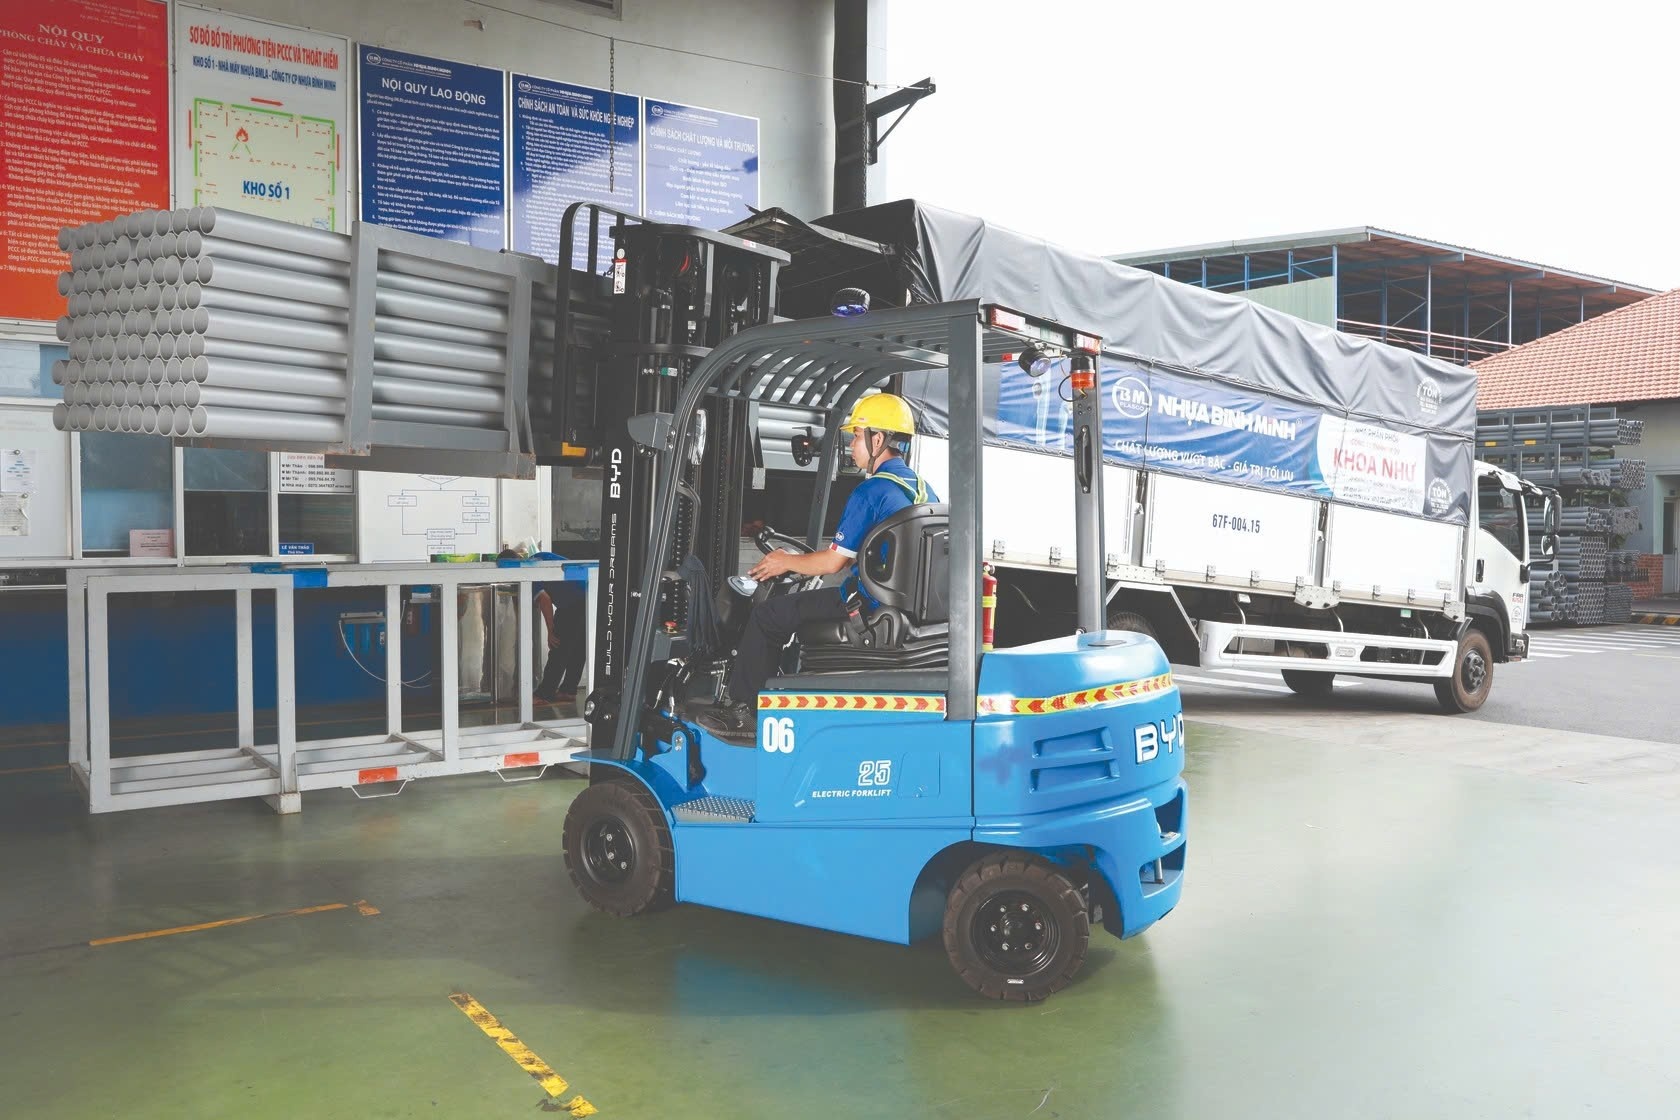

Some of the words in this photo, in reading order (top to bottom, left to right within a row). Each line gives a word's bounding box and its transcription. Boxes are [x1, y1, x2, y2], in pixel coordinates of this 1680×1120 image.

[37, 36, 68, 48] CHÁY
[117, 50, 145, 63] CHÁY
[38, 24, 69, 38] NỘI
[71, 30, 105, 44] QUY
[189, 26, 199, 44] SƠ
[199, 24, 210, 46] ĐỒ
[211, 26, 221, 48] BỐ
[221, 30, 233, 51] TRÍ
[233, 33, 261, 56] PHƯƠNG
[261, 38, 276, 62] TIỆN
[277, 43, 293, 63] PCCC
[293, 44, 302, 63] VÀ
[302, 47, 323, 67] THOÁT
[323, 47, 339, 70] HIỂM
[192, 55, 204, 67] KHO
[204, 55, 212, 69] SỐ
[218, 60, 229, 72] NHÀ
[229, 61, 240, 74] MÁY
[240, 64, 255, 79] NHỰA
[255, 67, 269, 79] BMLA
[271, 68, 285, 83] CÔNG
[285, 72, 291, 84] TY
[291, 75, 298, 85] CP
[312, 77, 324, 89] BÌNH
[324, 80, 336, 91] MINH
[381, 77, 401, 92] NỘI
[404, 82, 428, 95] QUY
[430, 86, 453, 99] LAO
[455, 91, 486, 105] ĐỘNG
[518, 96, 534, 109] CHÍNH
[534, 97, 548, 113] SÁCH
[548, 103, 556, 114] AN
[556, 102, 570, 117] TOÀN
[571, 105, 578, 118] VÀ
[578, 106, 589, 120] SỨC
[603, 112, 617, 126] NGỀ
[617, 116, 635, 130] NGHIỆP
[242, 180, 267, 197] KHO
[268, 180, 283, 199] SỐ
[284, 187, 290, 200] 1
[1119, 401, 1145, 412] PLASCO
[1157, 394, 1210, 427] NHỰA
[609, 448, 622, 499] BYD
[1115, 439, 1143, 455] CHẤT
[1208, 456, 1226, 471] BẬC
[1233, 459, 1249, 474] GIÁ
[1250, 463, 1263, 478] TRỊ
[1265, 465, 1279, 479] TỐI
[1280, 471, 1295, 482] ƯU
[1333, 447, 1377, 476] KHOA
[1382, 457, 1417, 482] NHƯ
[1212, 513, 1261, 533] 67F-004.15
[605, 630, 613, 676] BUILD
[609, 513, 617, 579] DREAMS
[762, 716, 795, 753] 06
[1134, 711, 1184, 764] BYD
[857, 760, 892, 786] 25
[811, 789, 850, 798] ELECTRIC
[851, 789, 892, 797] FORKLIFT
